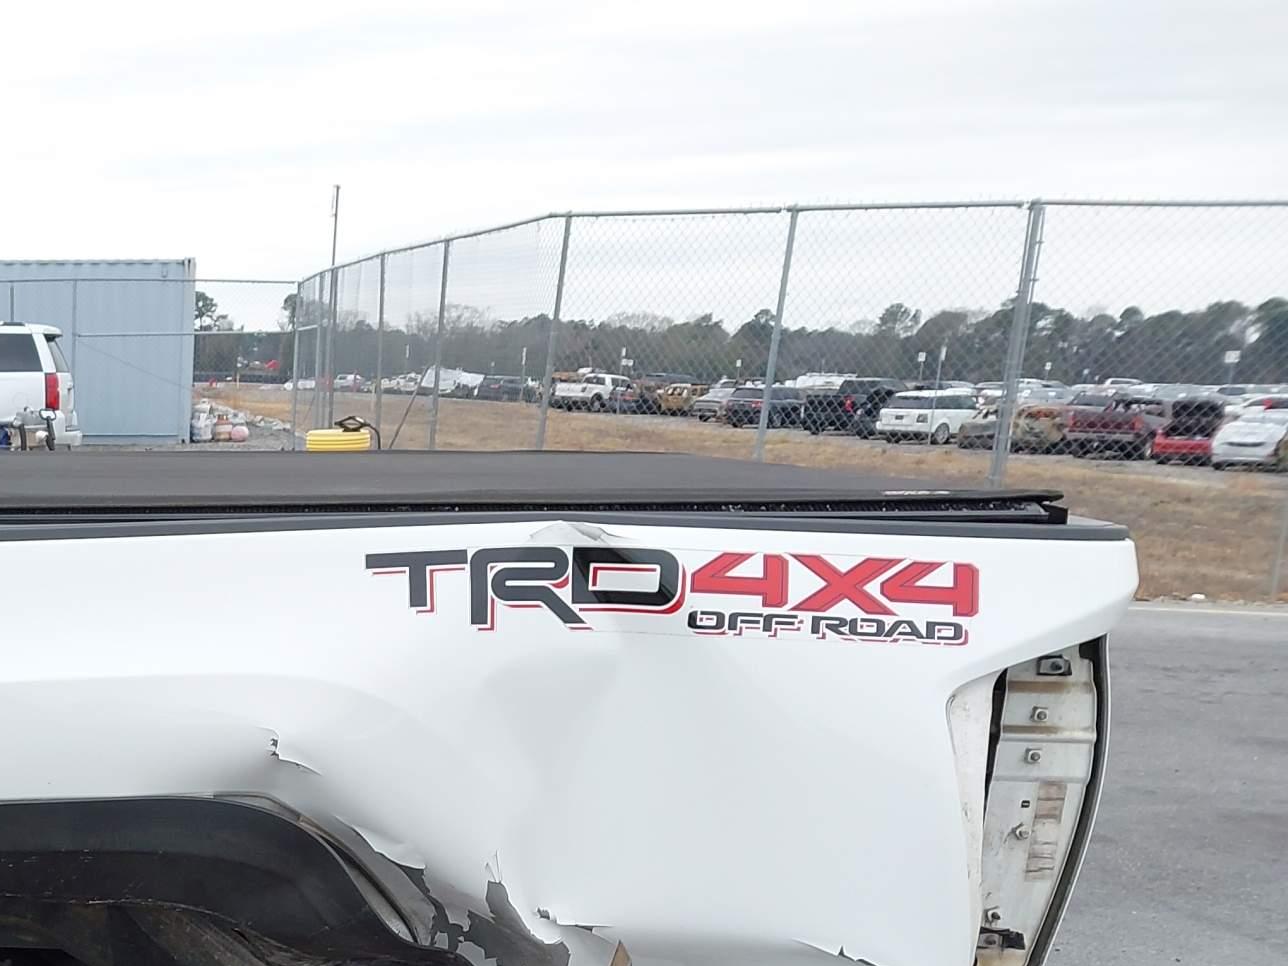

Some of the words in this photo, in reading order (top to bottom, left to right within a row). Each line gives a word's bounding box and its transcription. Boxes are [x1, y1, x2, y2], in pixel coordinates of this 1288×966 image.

[365, 546, 685, 630] TRD
[690, 552, 979, 617] 4X4
[687, 610, 804, 637] OFF
[812, 615, 968, 646] ROAD
